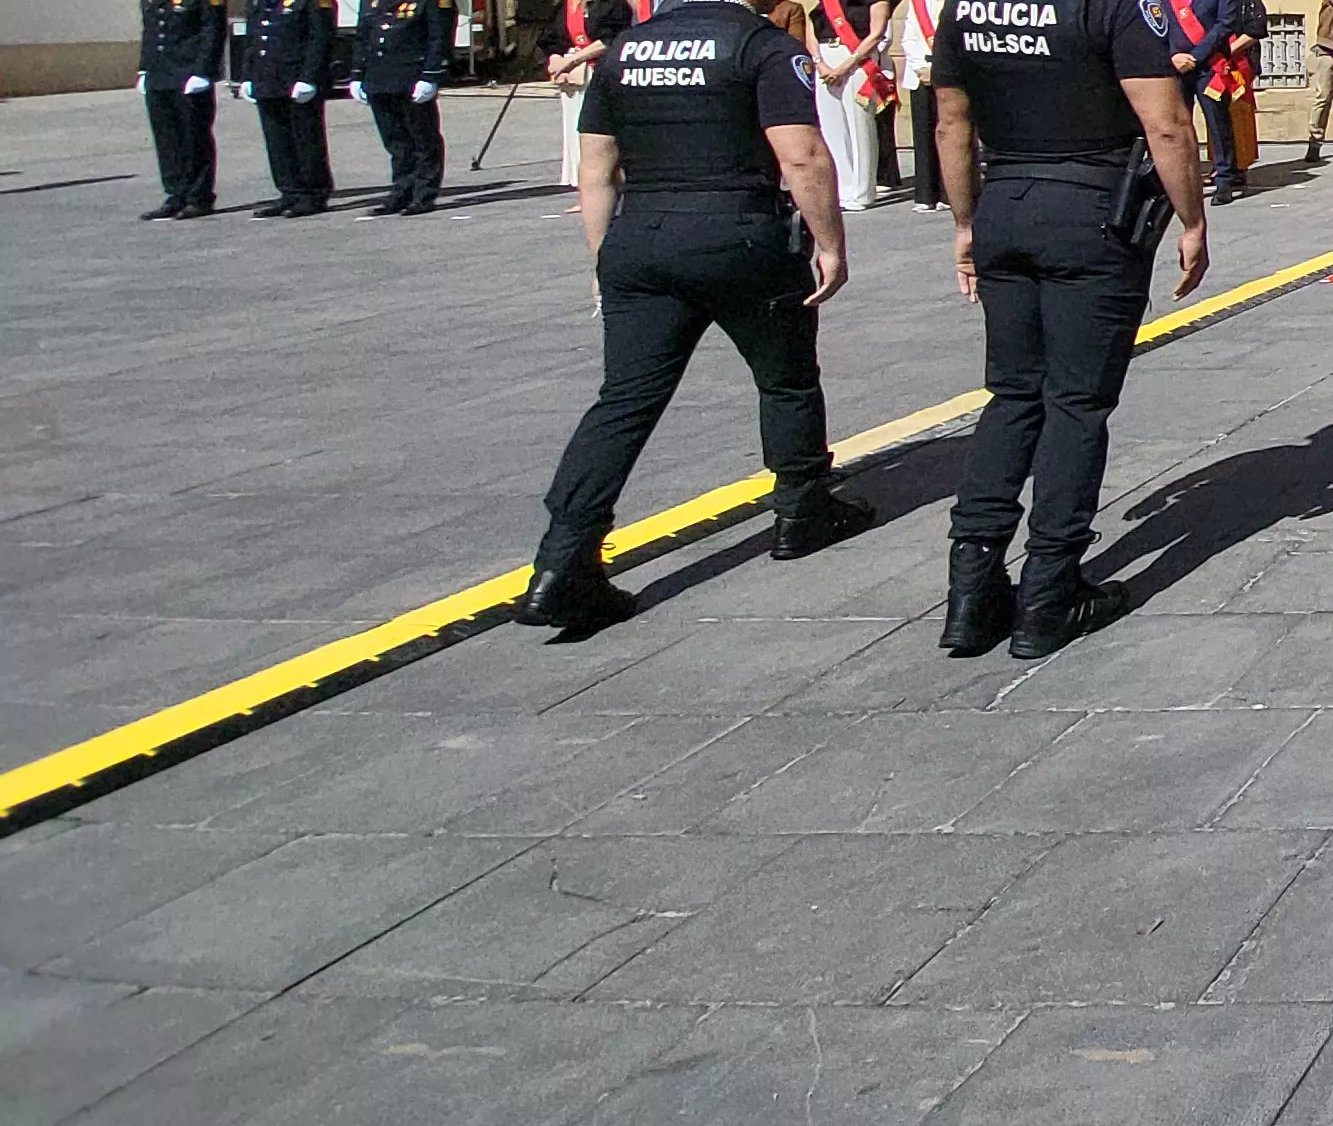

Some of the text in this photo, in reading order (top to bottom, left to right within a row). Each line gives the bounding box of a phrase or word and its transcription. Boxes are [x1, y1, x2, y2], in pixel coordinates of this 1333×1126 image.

[955, 0, 1058, 27] POLICIA
[619, 39, 716, 62] POLICIA
[963, 31, 1051, 56] HUESCA
[619, 67, 706, 87] HUESCA
